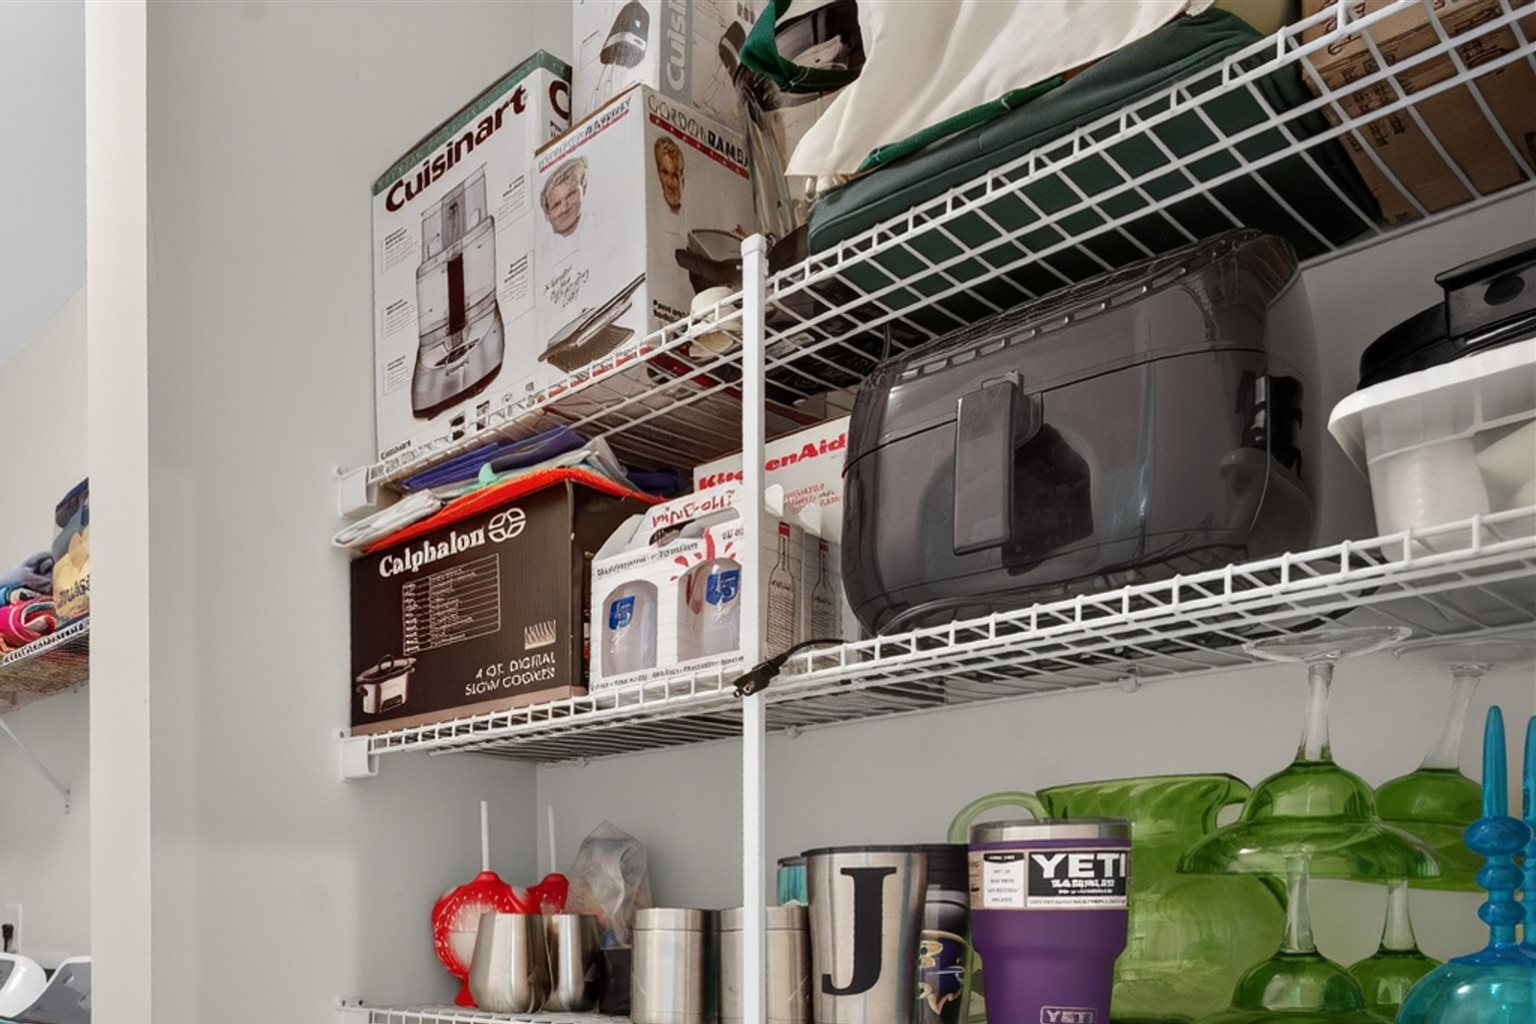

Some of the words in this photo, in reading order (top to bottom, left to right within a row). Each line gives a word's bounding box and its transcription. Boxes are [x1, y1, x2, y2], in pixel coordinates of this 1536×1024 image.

[385, 84, 527, 213] Cuisinart
[378, 526, 486, 578] Calphalon
[510, 651, 556, 673] DIGITAL
[465, 678, 501, 696] SLOW
[1031, 852, 1126, 879] YETI
[821, 866, 897, 996] J
[1046, 1009, 1094, 1024] YETI
